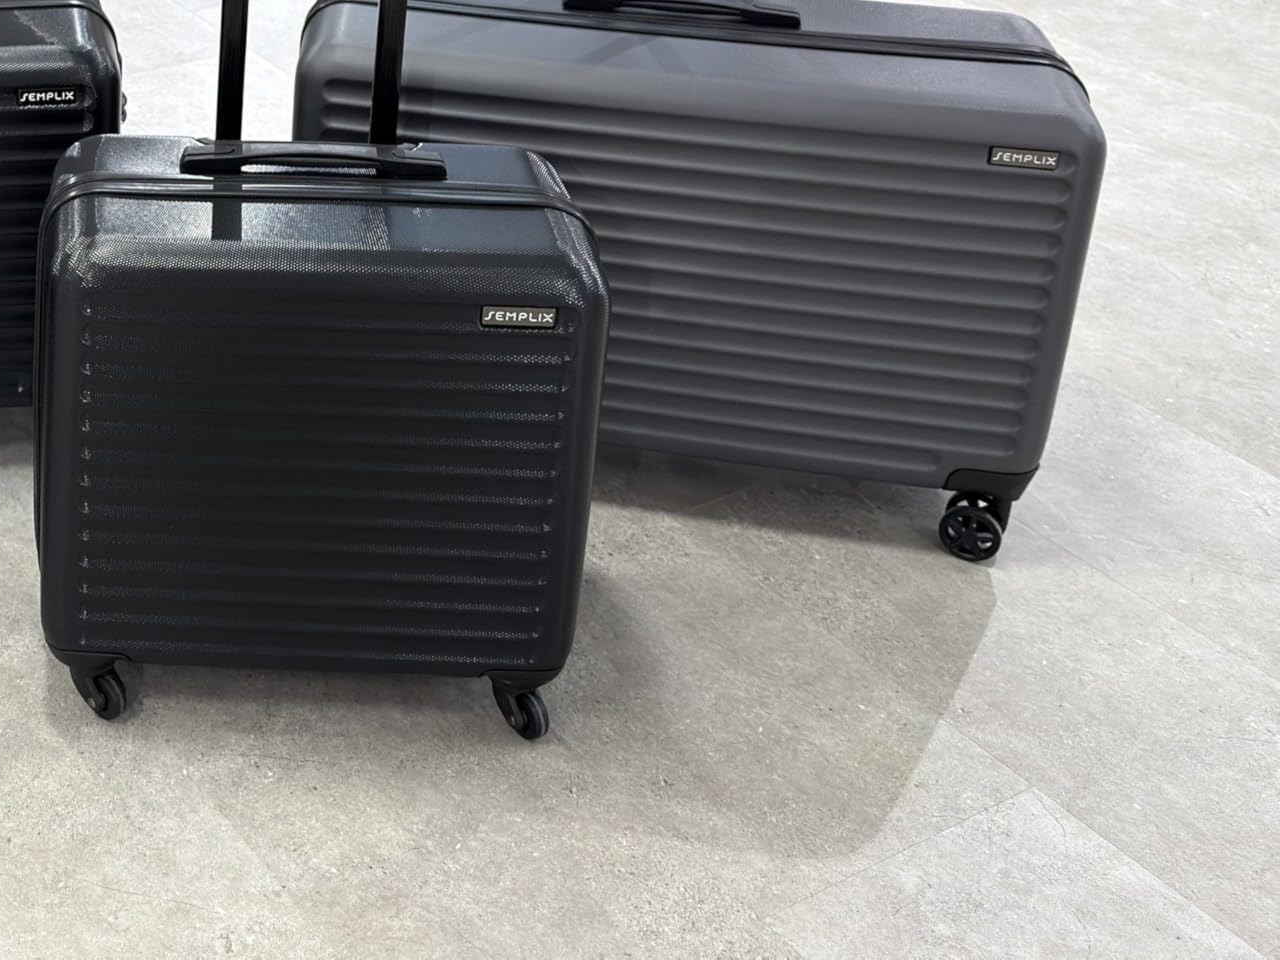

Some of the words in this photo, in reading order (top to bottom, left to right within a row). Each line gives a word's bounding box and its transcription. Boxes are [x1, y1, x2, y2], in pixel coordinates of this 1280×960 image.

[20, 91, 74, 102] SEMPLIX
[992, 152, 1057, 166] SEMPLIX
[484, 311, 554, 323] SEMPLIX
